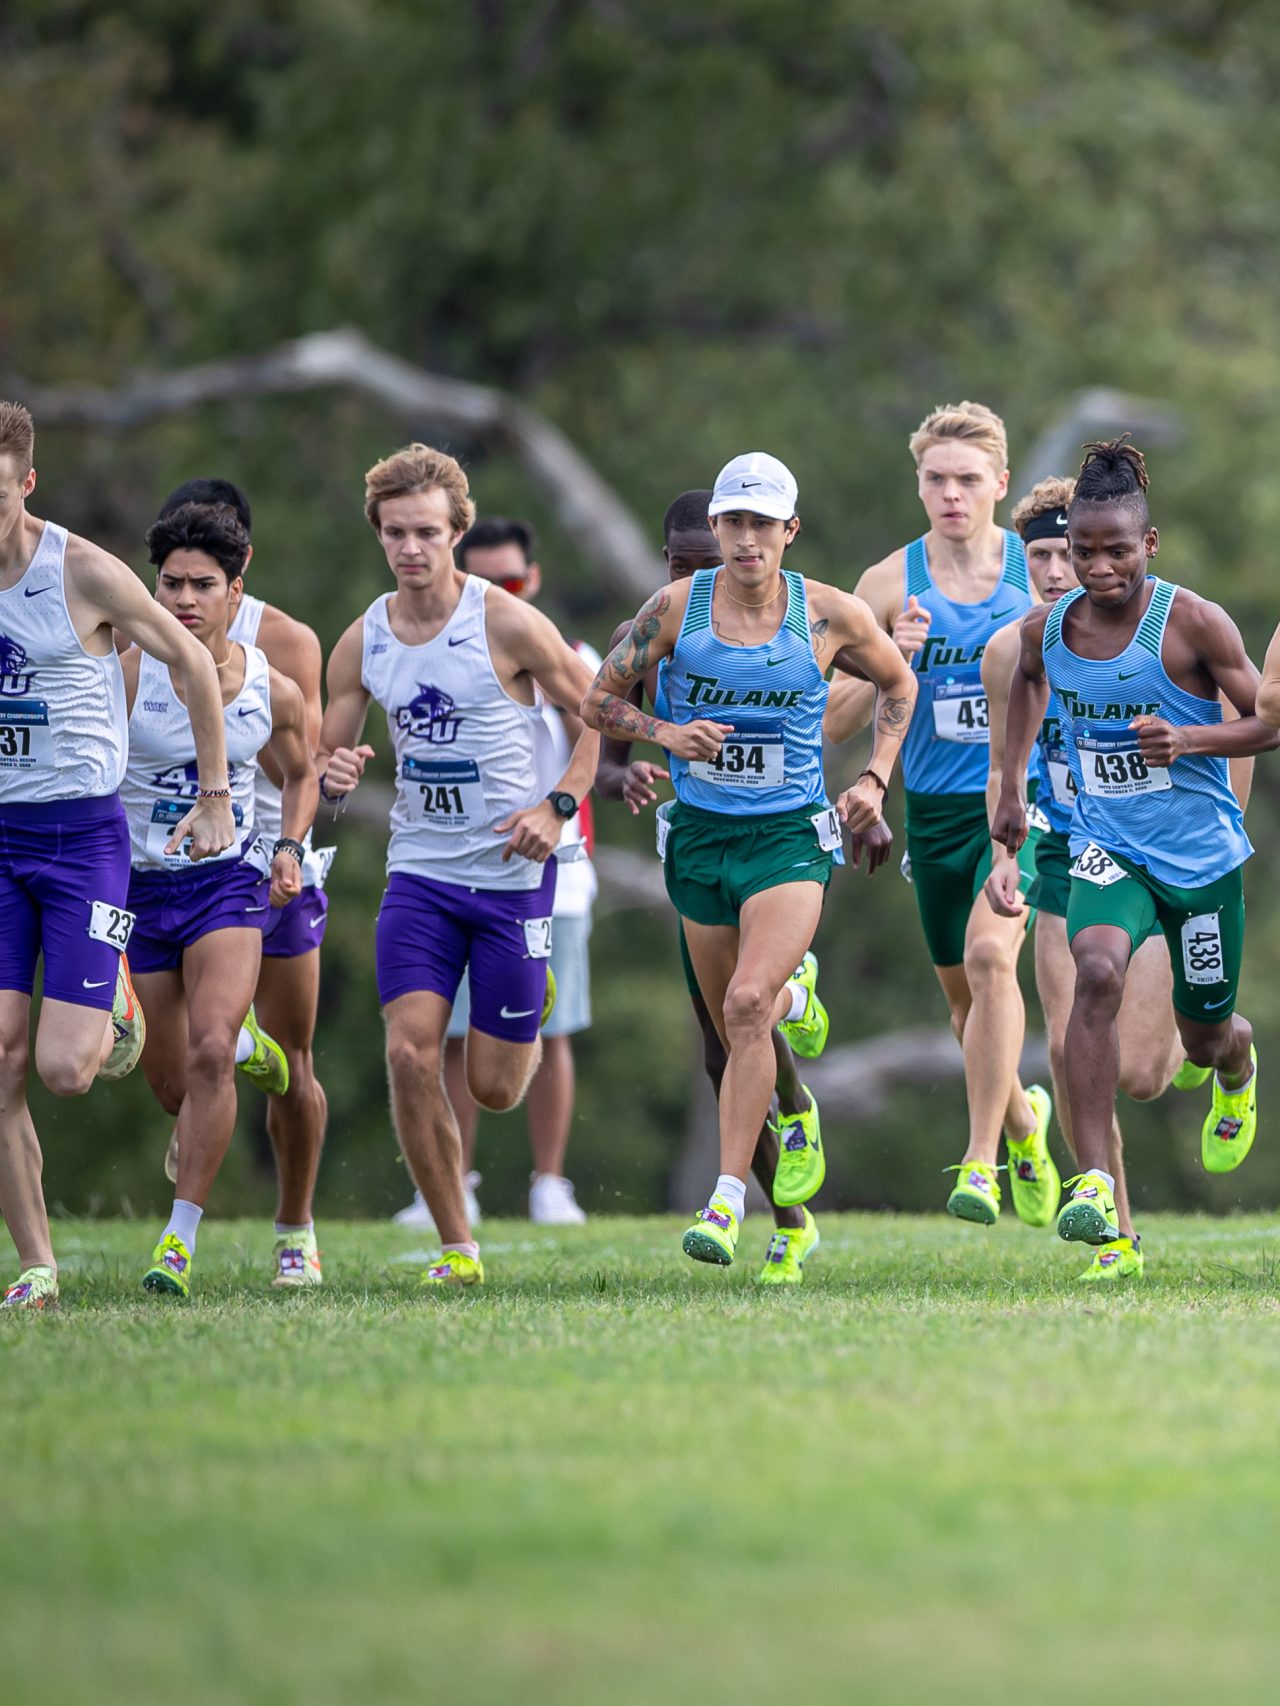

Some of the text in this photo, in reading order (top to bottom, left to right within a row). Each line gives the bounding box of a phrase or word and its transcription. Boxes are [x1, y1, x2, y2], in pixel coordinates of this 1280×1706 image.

[686, 672, 804, 707] TULANE
[1057, 688, 1161, 720] TULANE
[707, 745, 765, 773] 434
[1095, 752, 1148, 783] 438
[420, 785, 464, 814] 241
[1188, 932, 1221, 971] 438
